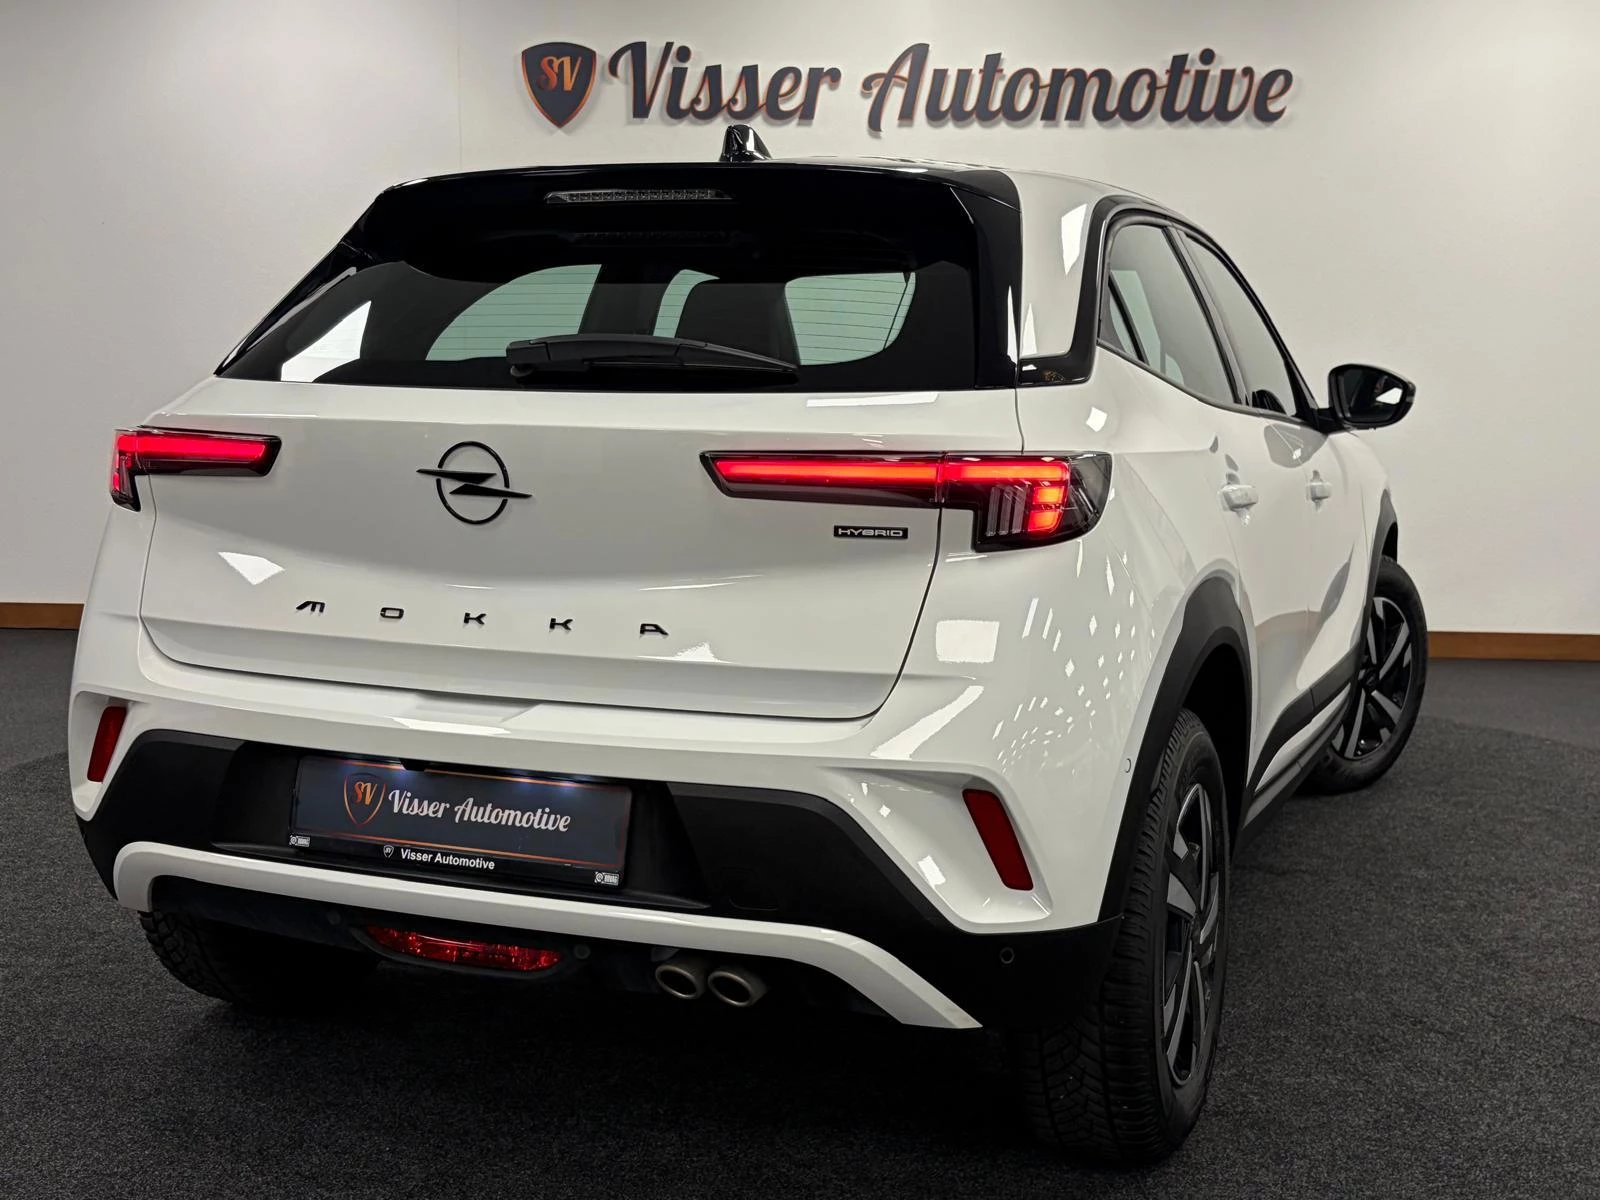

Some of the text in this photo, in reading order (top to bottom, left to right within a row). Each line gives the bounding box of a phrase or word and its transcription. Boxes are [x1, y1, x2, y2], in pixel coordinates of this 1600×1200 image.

[537, 56, 582, 92] SV
[609, 40, 1292, 133] Visser Automotive
[838, 528, 903, 537] HYBRID
[388, 789, 571, 832] Visser Automotive
[400, 848, 496, 870] Visser Automotive
